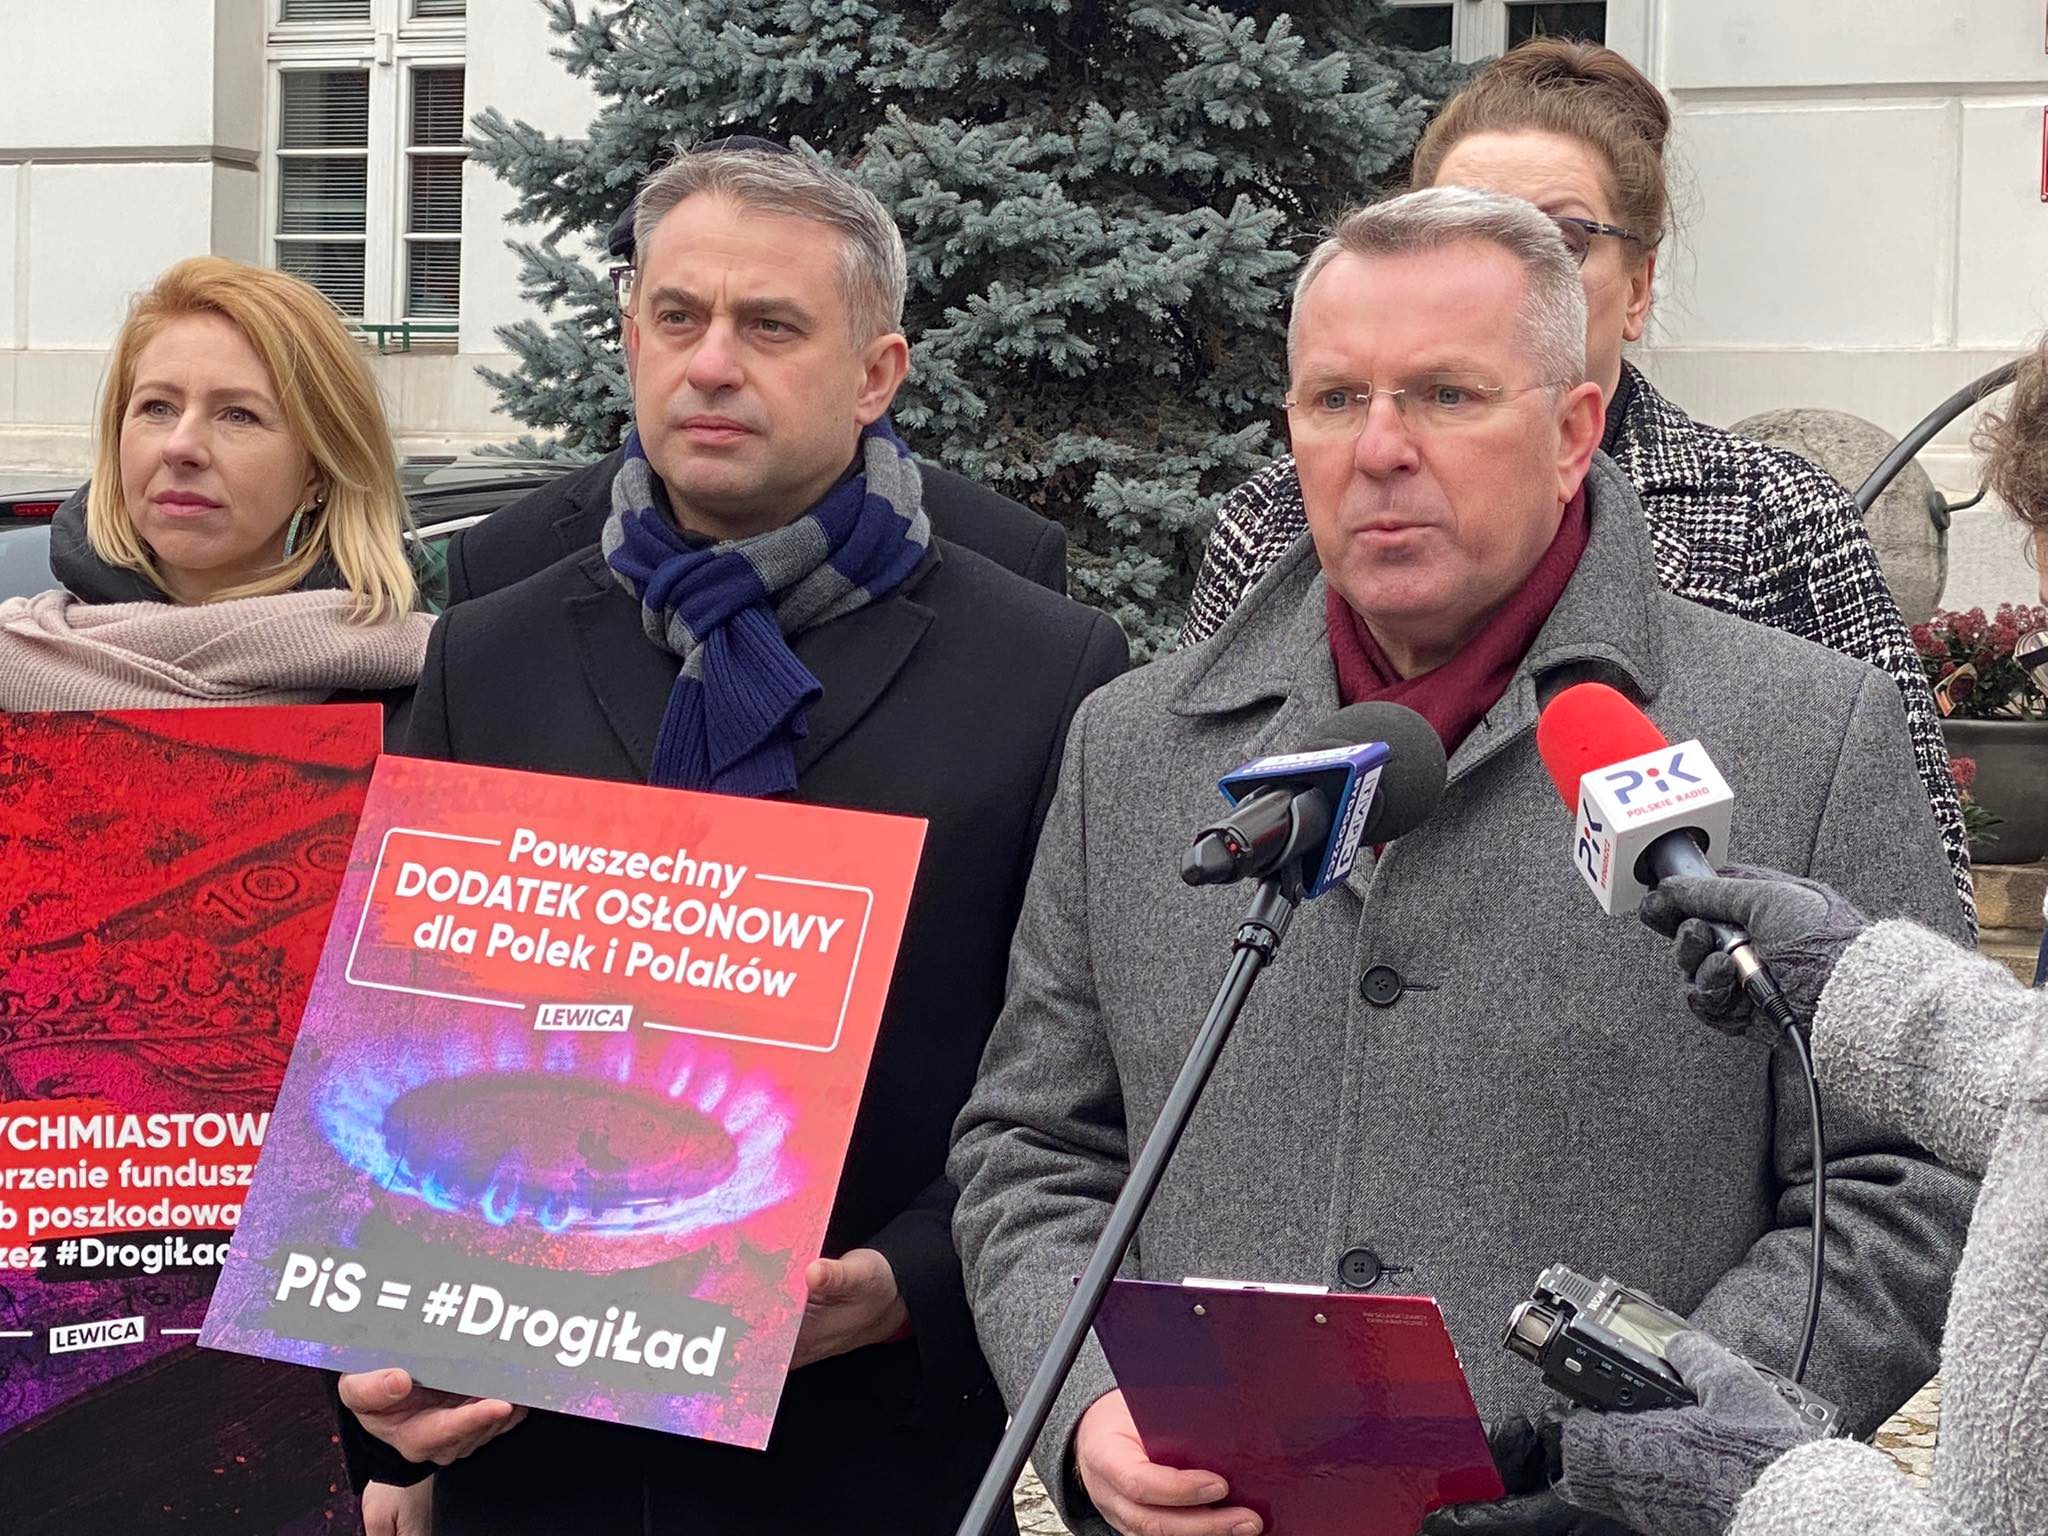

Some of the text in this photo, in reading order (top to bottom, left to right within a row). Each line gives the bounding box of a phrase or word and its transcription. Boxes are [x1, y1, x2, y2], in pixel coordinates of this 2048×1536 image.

[1605, 752, 1702, 805] PiK
[1626, 786, 1710, 818] POLSKIE RADIO
[508, 828, 748, 899] Powszechny
[396, 863, 845, 953] DODATEK OSŁONOWY
[413, 915, 797, 998] dla Polek i Polaków
[540, 1007, 625, 1028] LEWICA
[0, 1158, 257, 1188] rzenie fundusz
[55, 1321, 139, 1348] LEWICA
[275, 1253, 368, 1313] PiS
[421, 1282, 727, 1377] #DrogiŁad
